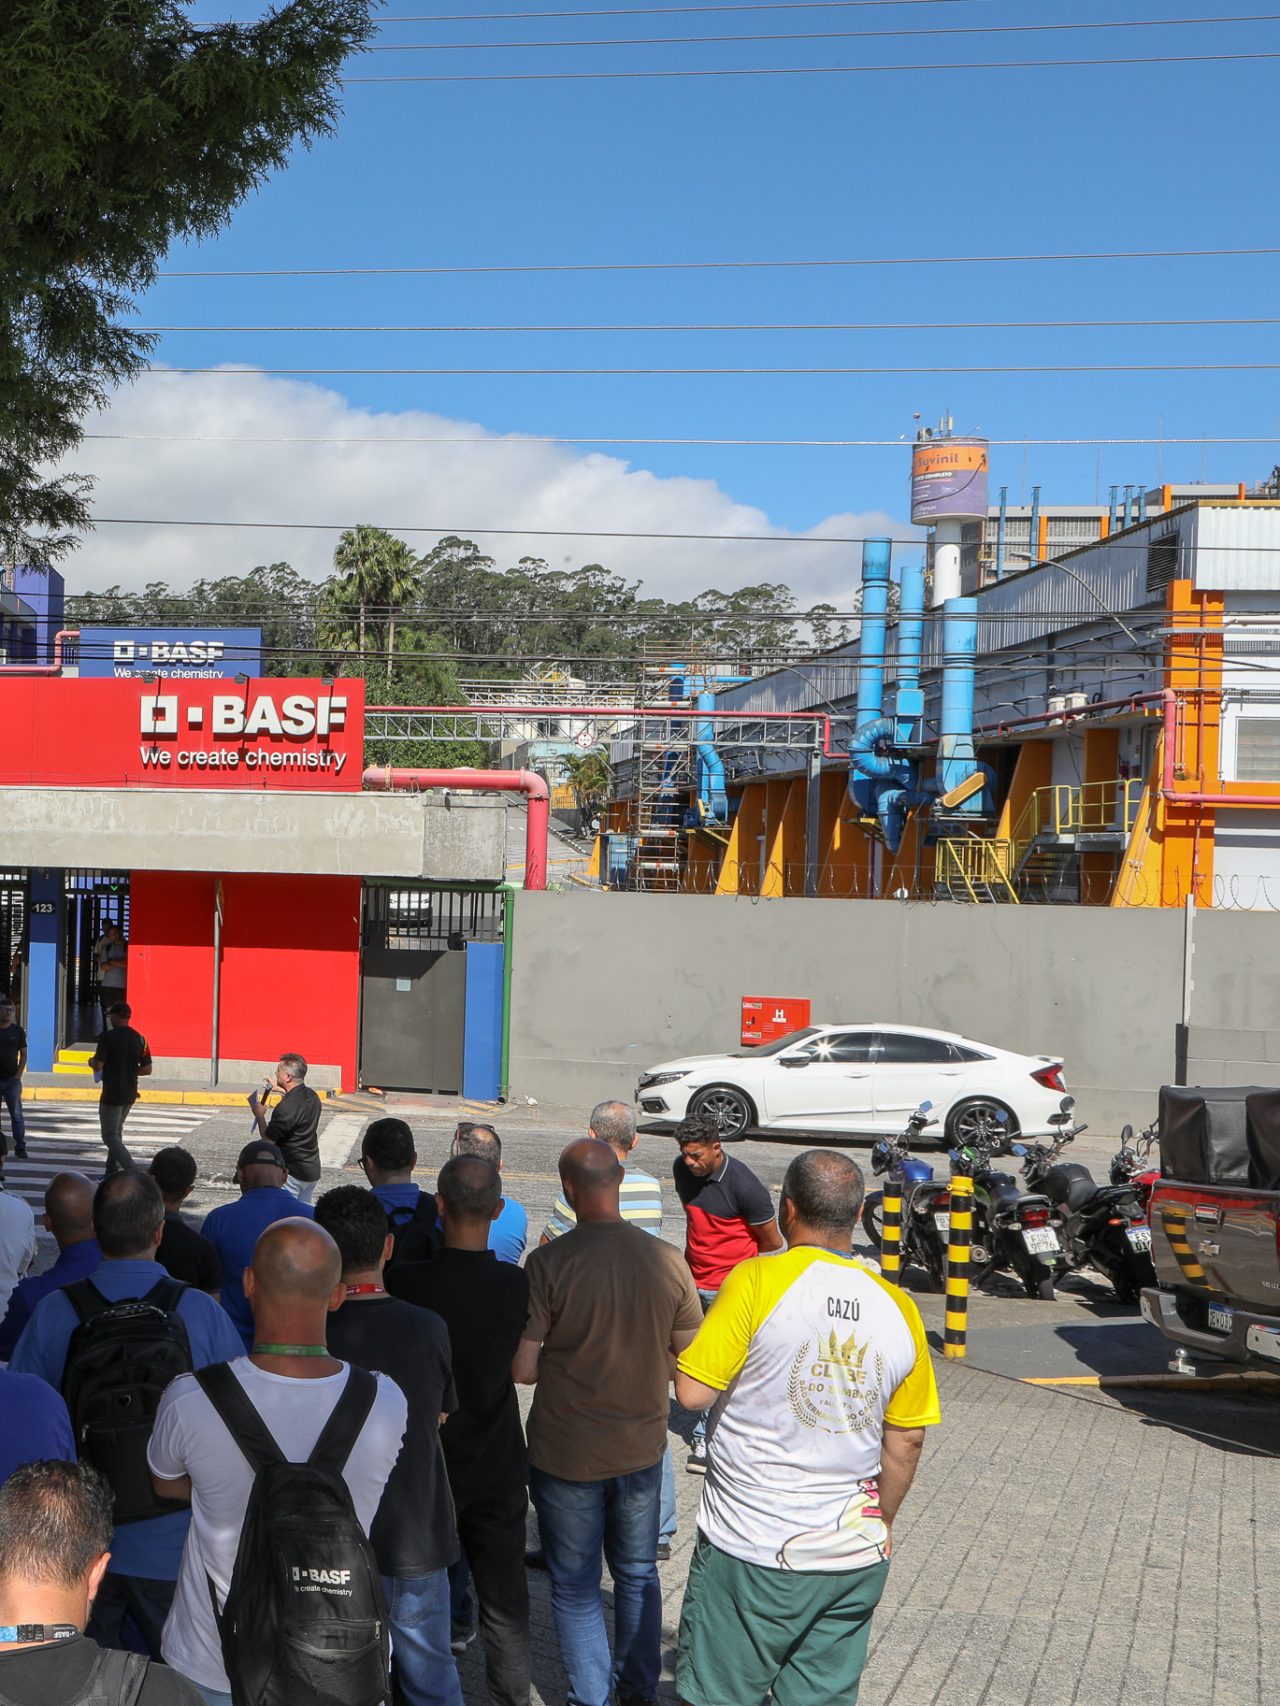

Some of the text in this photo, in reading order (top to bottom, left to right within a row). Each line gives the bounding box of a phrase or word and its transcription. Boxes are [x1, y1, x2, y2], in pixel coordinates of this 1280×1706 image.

[152, 640, 224, 663] BASF
[114, 668, 132, 678] We
[171, 668, 224, 679] chemistry
[212, 695, 347, 736] BASF
[140, 746, 347, 770] We create chemistry
[35, 903, 53, 913] 123
[775, 1009, 784, 1018] H
[827, 1297, 860, 1321] CAZÚ
[811, 1363, 867, 1385] CLUBE
[808, 1382, 824, 1393] DO
[308, 1568, 351, 1585] BASF
[321, 1587, 353, 1597] chemistry
